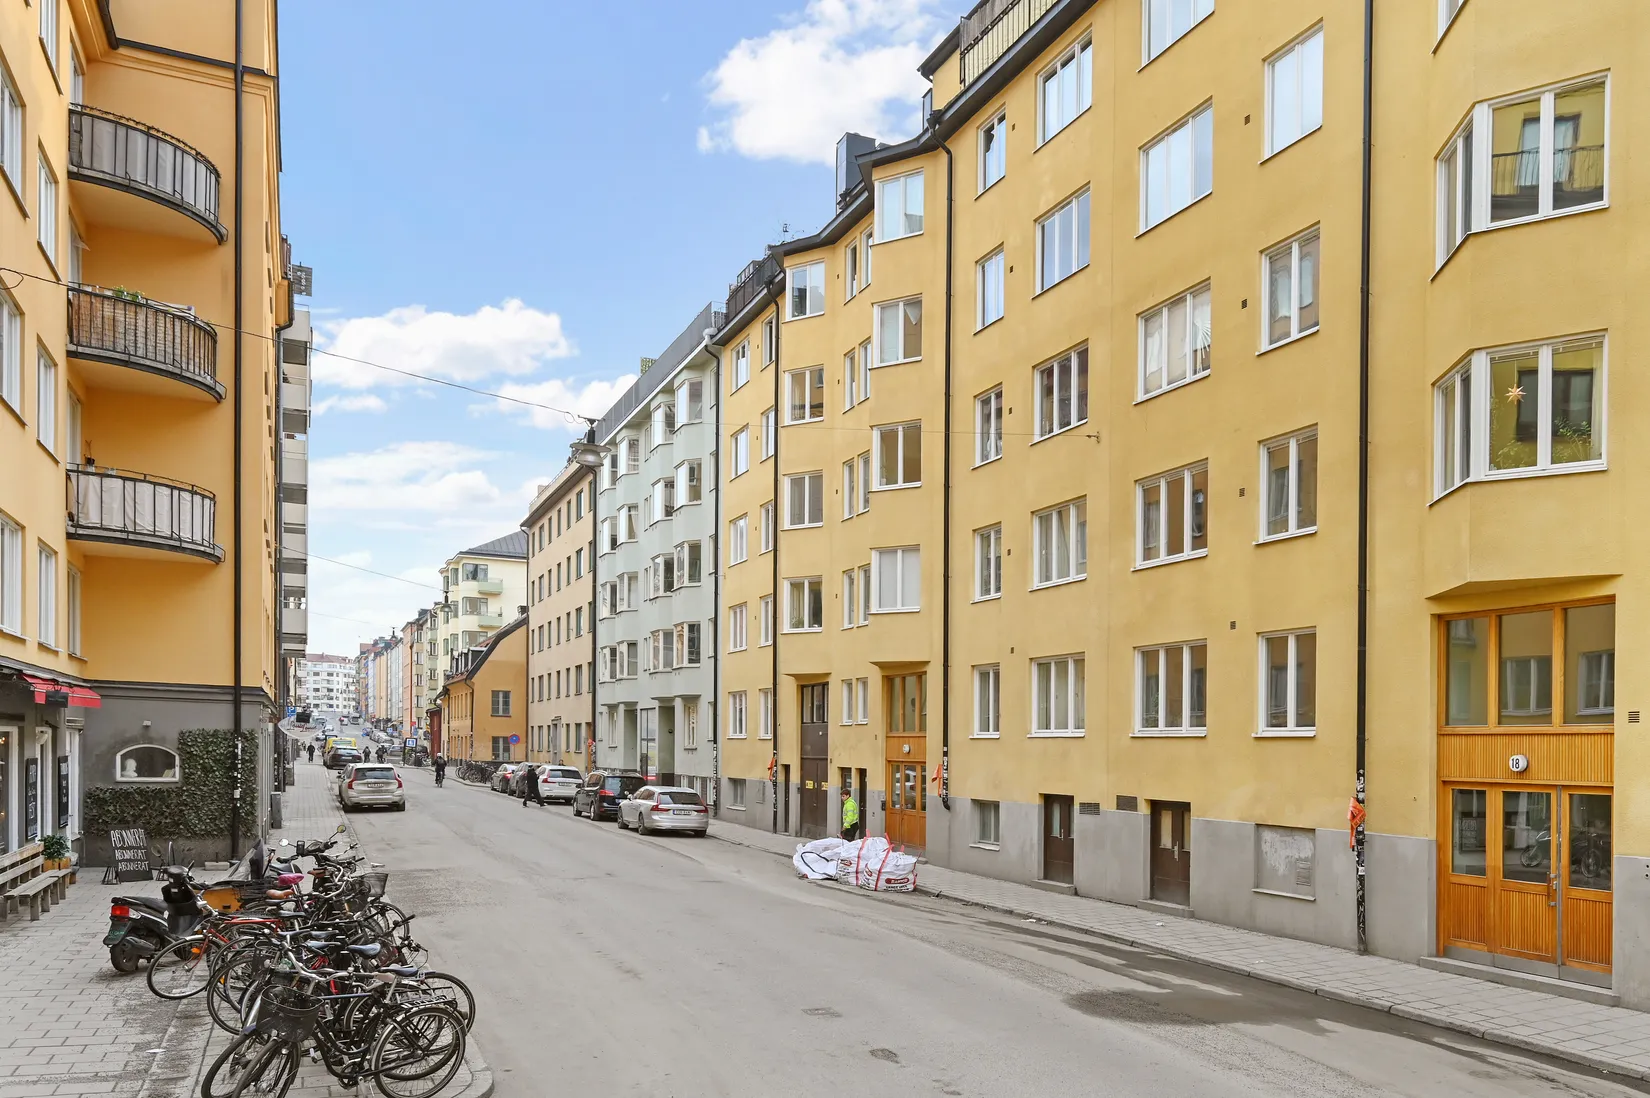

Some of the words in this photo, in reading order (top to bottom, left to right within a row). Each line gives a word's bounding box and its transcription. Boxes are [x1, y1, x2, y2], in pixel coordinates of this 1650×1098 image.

[1511, 757, 1520, 769] 18
[110, 828, 147, 848] ABONNERAT
[115, 849, 147, 860] ABONNERAT
[118, 861, 149, 871] ABONNERAT
